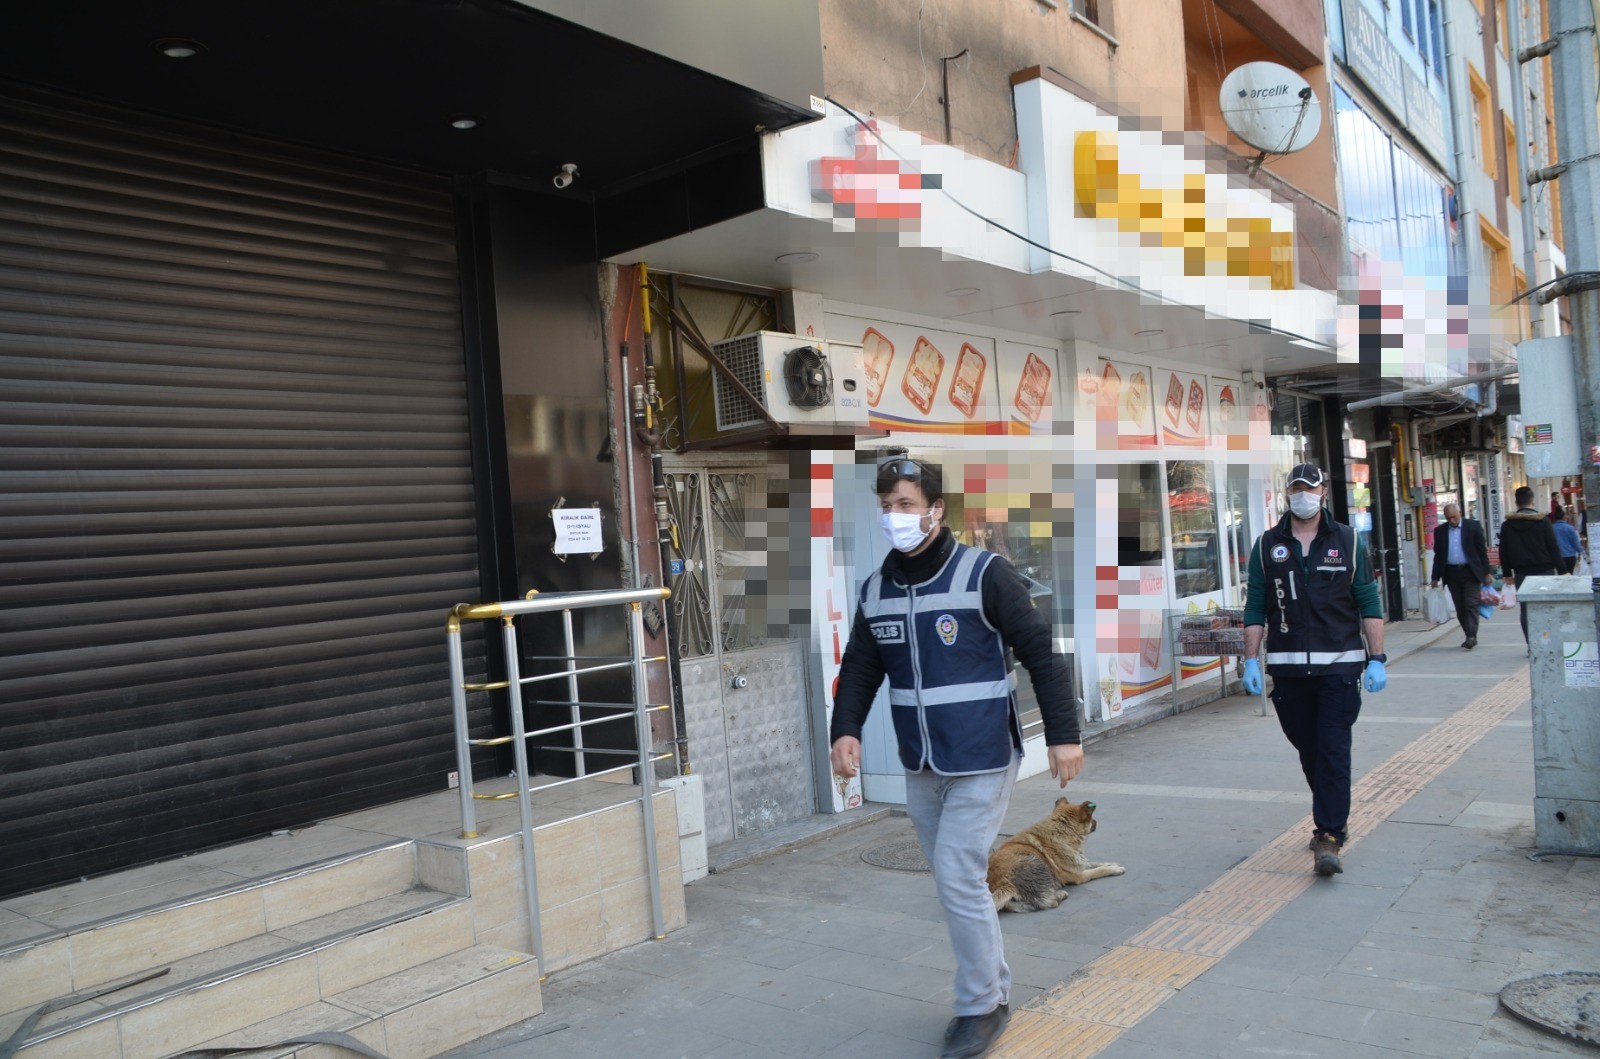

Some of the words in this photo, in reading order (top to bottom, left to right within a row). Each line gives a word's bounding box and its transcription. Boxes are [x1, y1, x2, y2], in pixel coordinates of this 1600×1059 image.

[1358, 7, 1401, 87] AVUKAT
[1250, 84, 1289, 99] arçelik
[1323, 556, 1342, 564] KOM
[1274, 578, 1289, 633] POLİS
